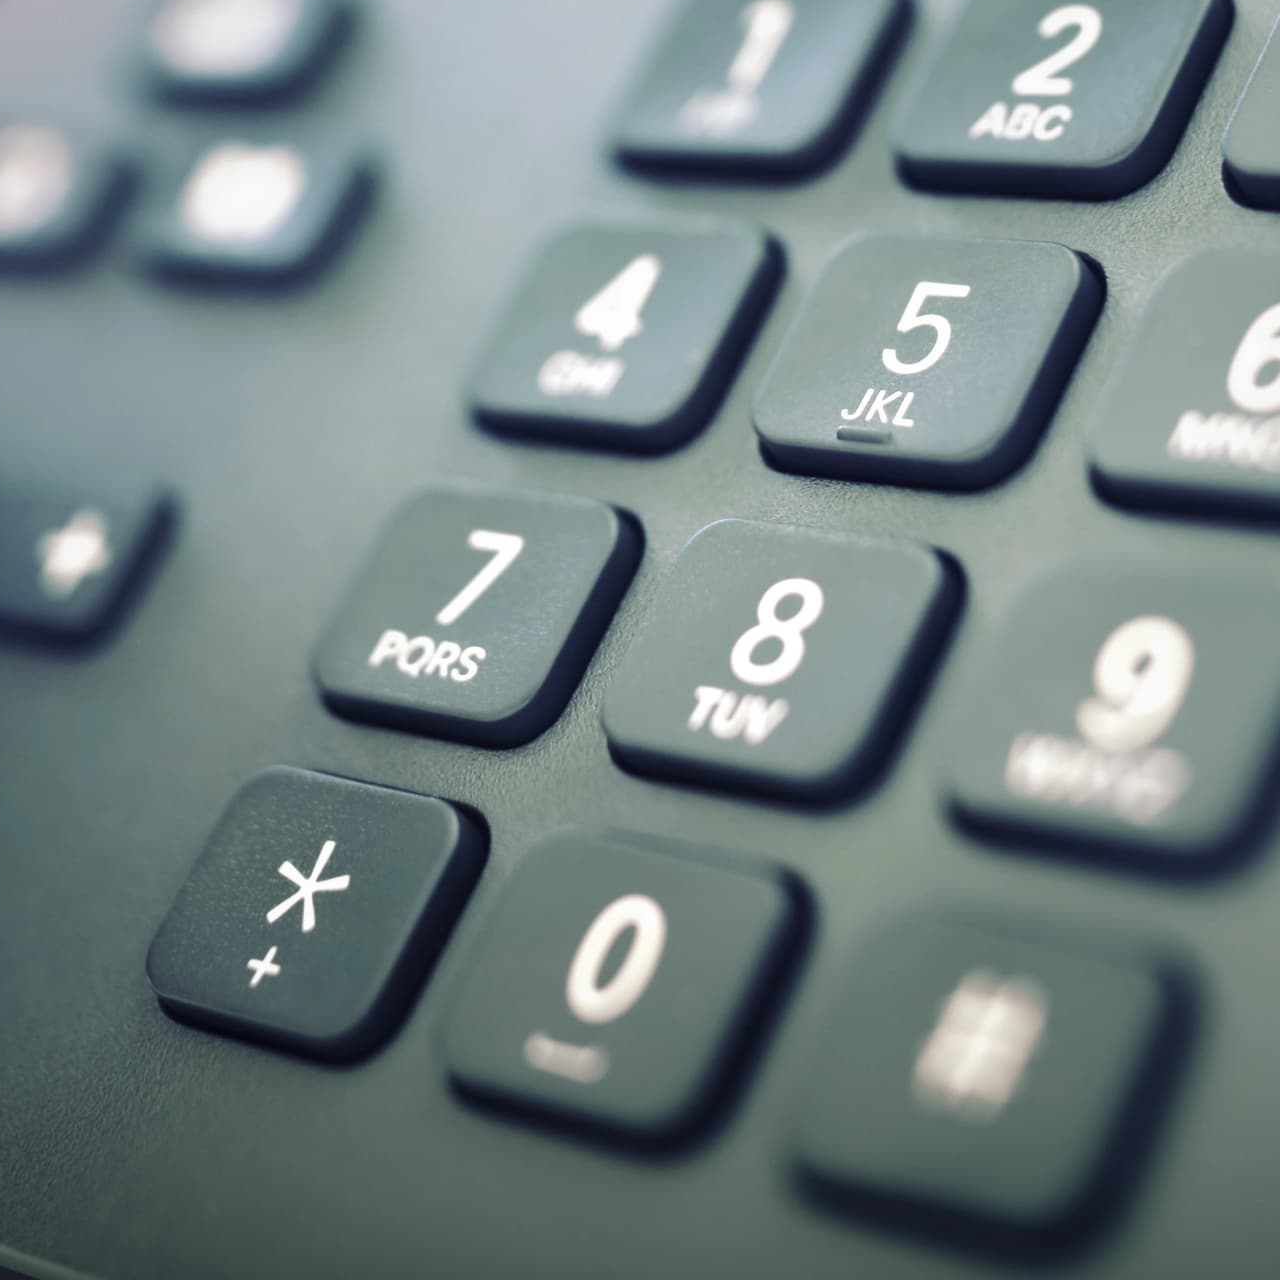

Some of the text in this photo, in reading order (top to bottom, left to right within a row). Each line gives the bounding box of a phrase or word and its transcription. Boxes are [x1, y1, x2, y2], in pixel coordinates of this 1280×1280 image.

[1012, 4, 1102, 98] 2
[969, 104, 1072, 143] ABC
[574, 254, 660, 350] 4
[880, 281, 970, 375] 5
[840, 389, 916, 427] JKL
[436, 530, 525, 626] 7
[368, 629, 486, 684] PQRS
[730, 578, 823, 686] 8
[687, 686, 788, 745] TUV
[1078, 615, 1194, 751] 9
[565, 895, 667, 1023] 0
